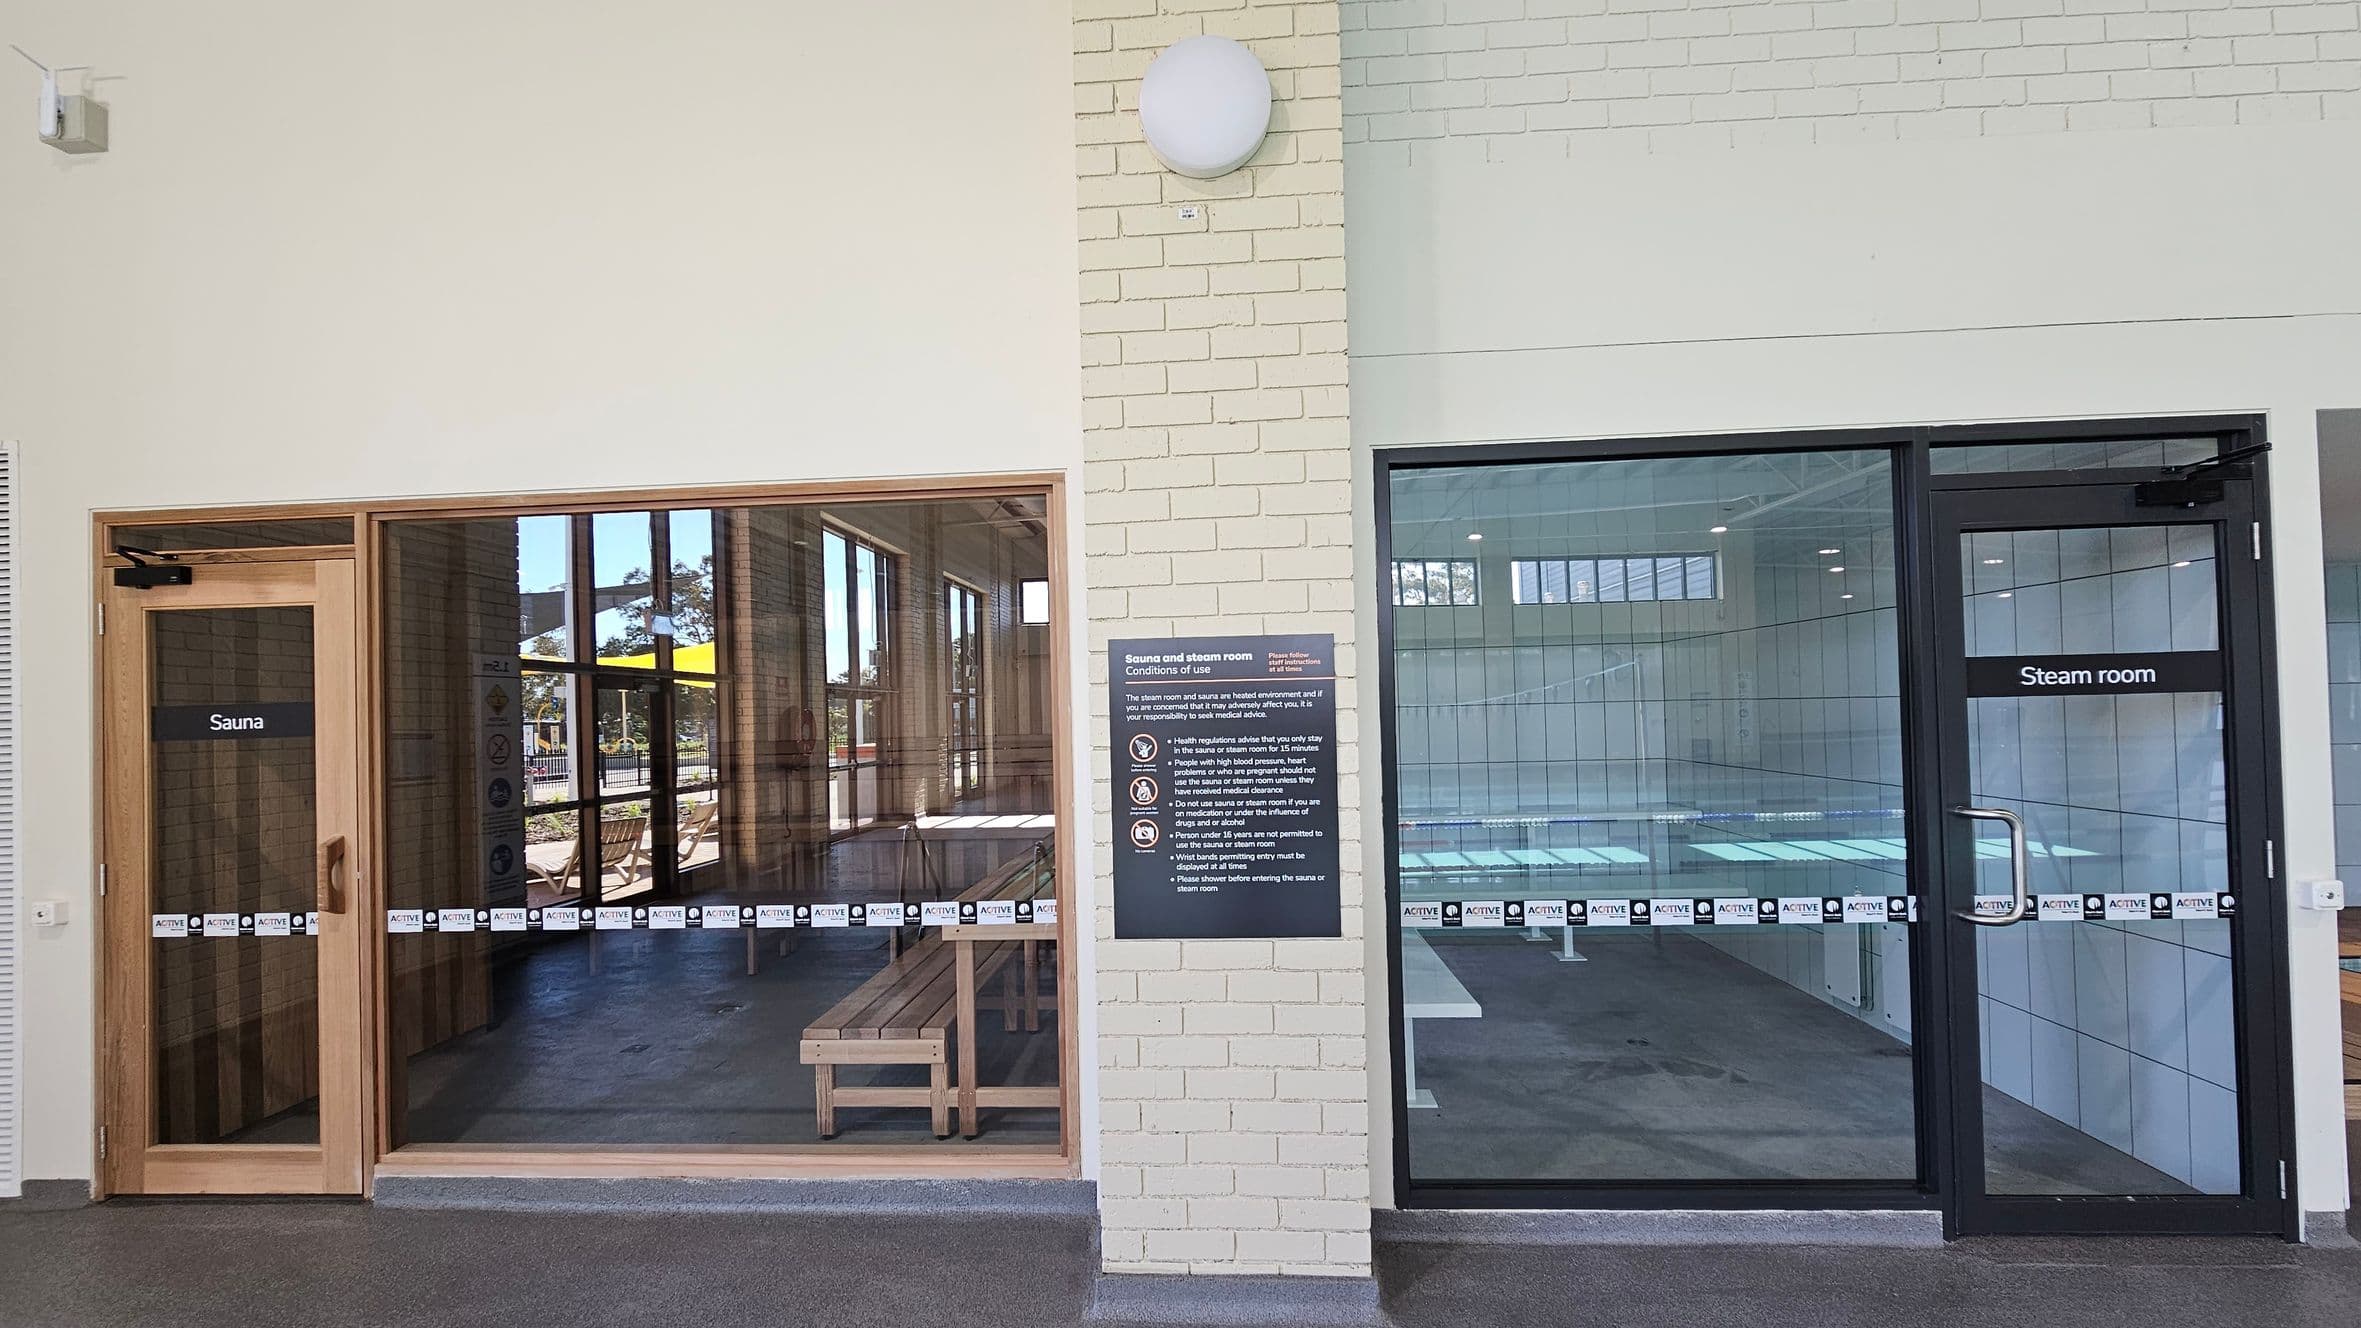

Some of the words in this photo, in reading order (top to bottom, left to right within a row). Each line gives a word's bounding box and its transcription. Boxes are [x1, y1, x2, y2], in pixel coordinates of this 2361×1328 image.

[1124, 653, 1160, 663] Sauna
[1162, 653, 1184, 662] and
[1185, 652, 1221, 662] steam
[1223, 652, 1252, 661] room
[1125, 664, 1178, 675] Conditions
[1179, 664, 1191, 674] of
[2021, 666, 2092, 686] Steam
[2098, 668, 2156, 684] room
[1125, 693, 1139, 701] The
[1183, 692, 1196, 700] and
[1232, 691, 1256, 699] heated
[1257, 690, 1301, 698] environment
[1317, 689, 1323, 697] if
[1152, 702, 1188, 710] concerned
[1189, 702, 1204, 710] that
[1227, 701, 1261, 710] adversely
[1262, 700, 1283, 708] affect
[1306, 699, 1312, 707] is
[1142, 712, 1188, 721] responsibility
[1197, 711, 1214, 719] seek
[1215, 710, 1242, 718] medical
[210, 714, 264, 730] Sauna
[1173, 736, 1197, 744] Health
[1198, 735, 1236, 745] regulations
[1237, 735, 1260, 743] advise
[1276, 736, 1290, 744] you
[1290, 734, 1306, 743] only
[1307, 734, 1322, 743] stay
[1173, 746, 1180, 754] in
[1268, 744, 1278, 752] for
[1280, 744, 1290, 752] 15
[1174, 758, 1198, 767] People
[1216, 758, 1232, 766] high
[1233, 757, 1253, 765] blood
[1287, 756, 1306, 764] heart
[1173, 768, 1206, 777] problems
[1216, 767, 1232, 775] who
[1246, 767, 1278, 776] pregnant
[1279, 766, 1302, 774] should
[1298, 775, 1314, 784] they
[1174, 787, 1191, 795] have
[1222, 786, 1249, 794] medical
[1250, 786, 1283, 794] clearance
[1185, 808, 1223, 817] medication
[1233, 808, 1254, 816] under
[1268, 807, 1300, 815] influence
[1300, 807, 1309, 815] of
[1175, 819, 1195, 828] drugs
[1220, 818, 1245, 826] alcohol
[1175, 831, 1199, 839] Person
[1233, 831, 1252, 839] years
[1279, 829, 1313, 838] permitted
[1219, 853, 1255, 861] permitting
[1256, 853, 1275, 861] entry
[1176, 862, 1209, 871] displayed
[1200, 874, 1227, 882] shower
[1227, 874, 1250, 882] before
[1251, 874, 1280, 883] entering
[1281, 873, 1293, 881] the
